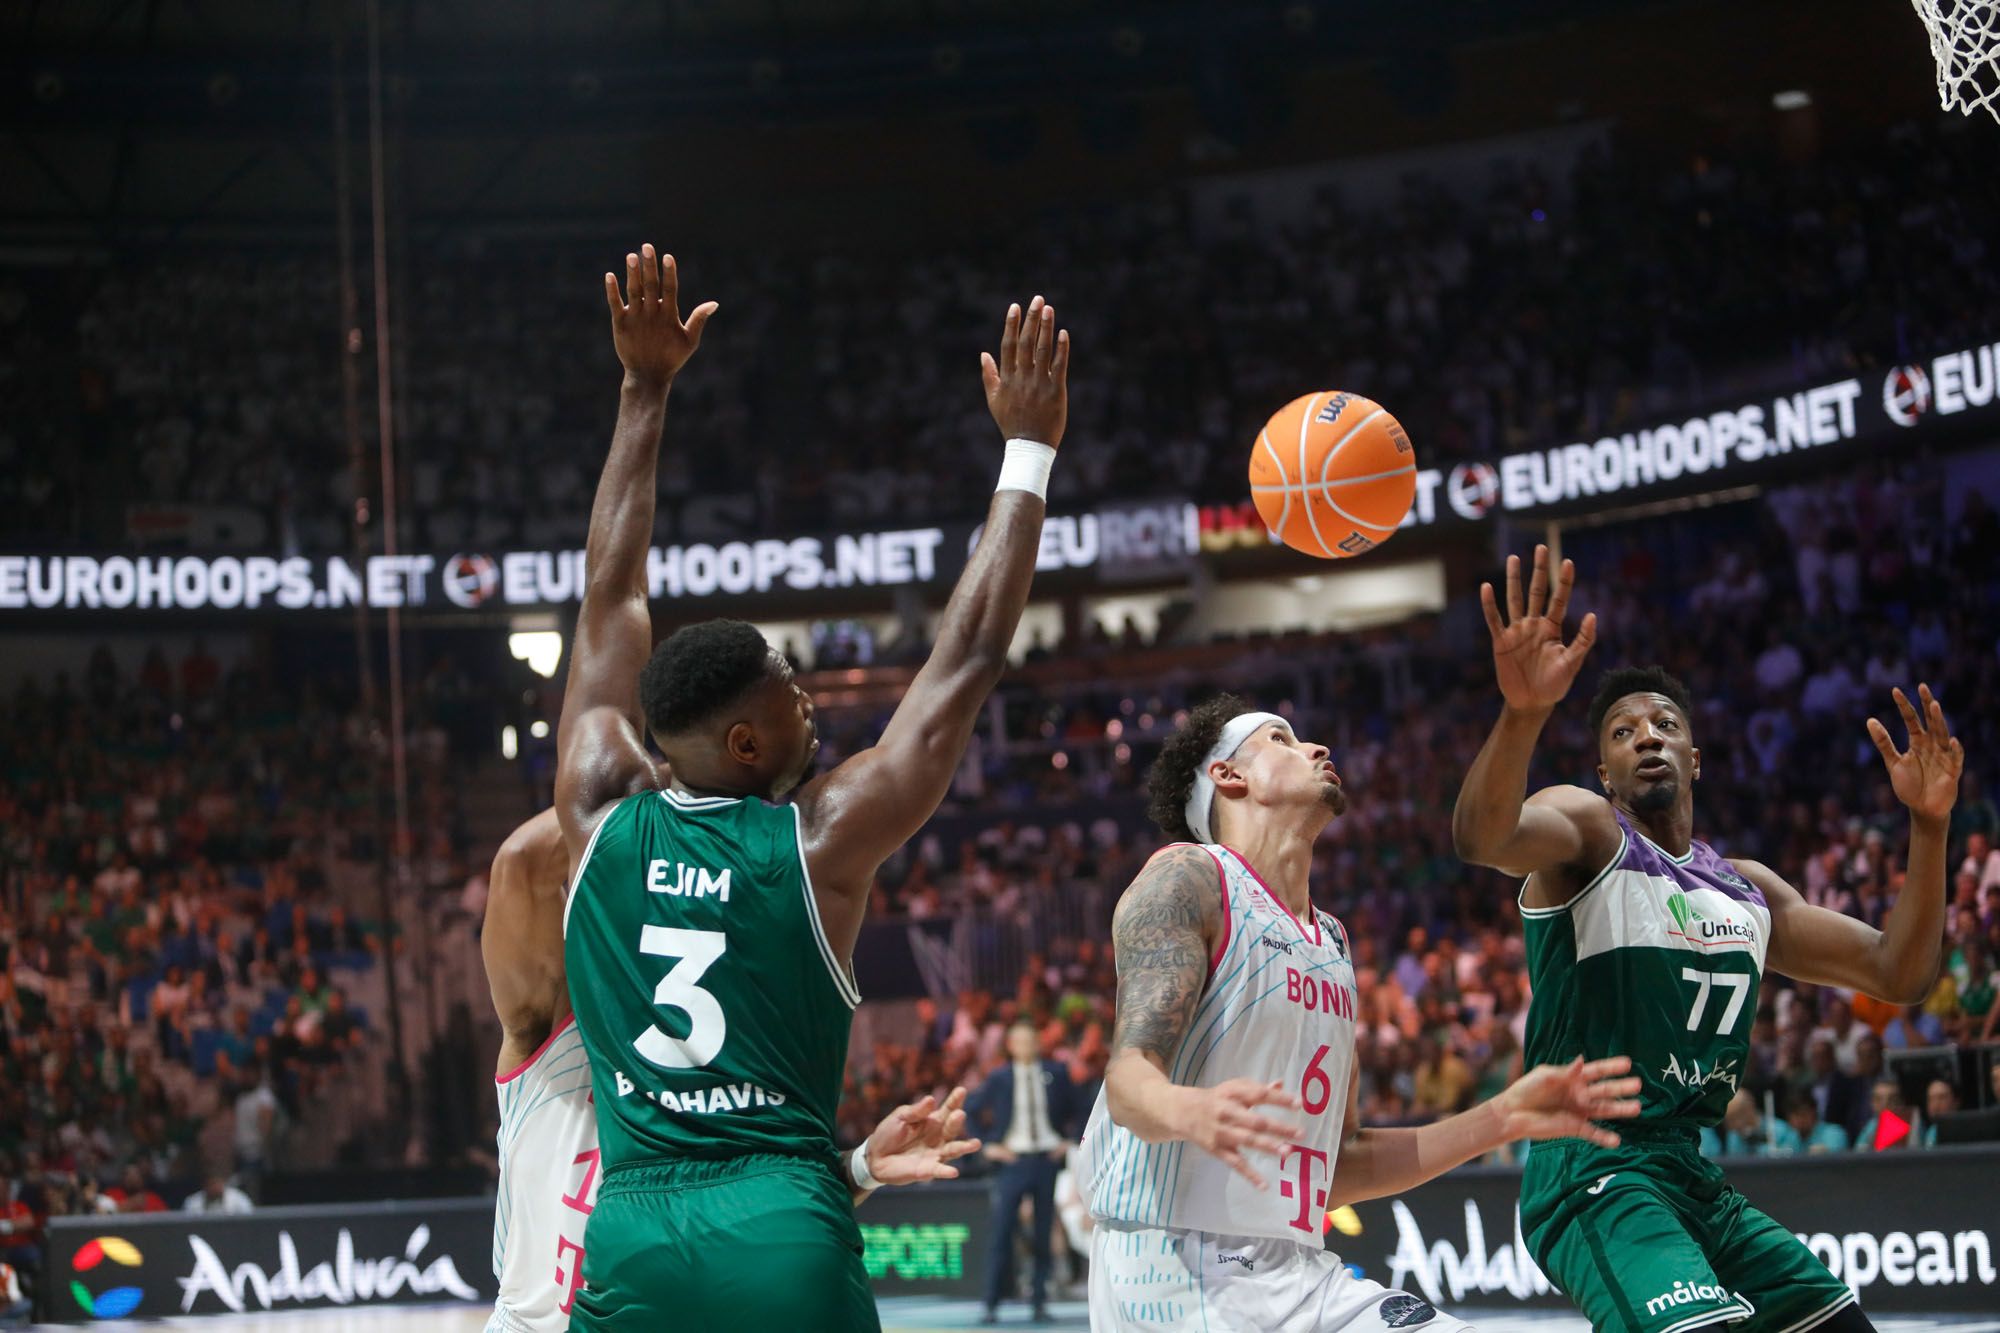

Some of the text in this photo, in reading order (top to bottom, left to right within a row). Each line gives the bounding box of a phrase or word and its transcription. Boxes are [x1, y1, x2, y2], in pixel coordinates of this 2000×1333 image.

[1932, 341, 2000, 415] EU
[1501, 378, 1861, 510] EUROHOOPS.NET
[0, 554, 434, 608] EUROHOOPS.NET
[502, 527, 944, 604] EUHOOPS.NET
[647, 859, 731, 902] EJIM
[632, 924, 726, 1068] 3
[1286, 966, 1353, 1022] BONN
[1682, 967, 1750, 1035] 77
[1302, 1044, 1331, 1115] 6
[1794, 1229, 1996, 1305] opean
